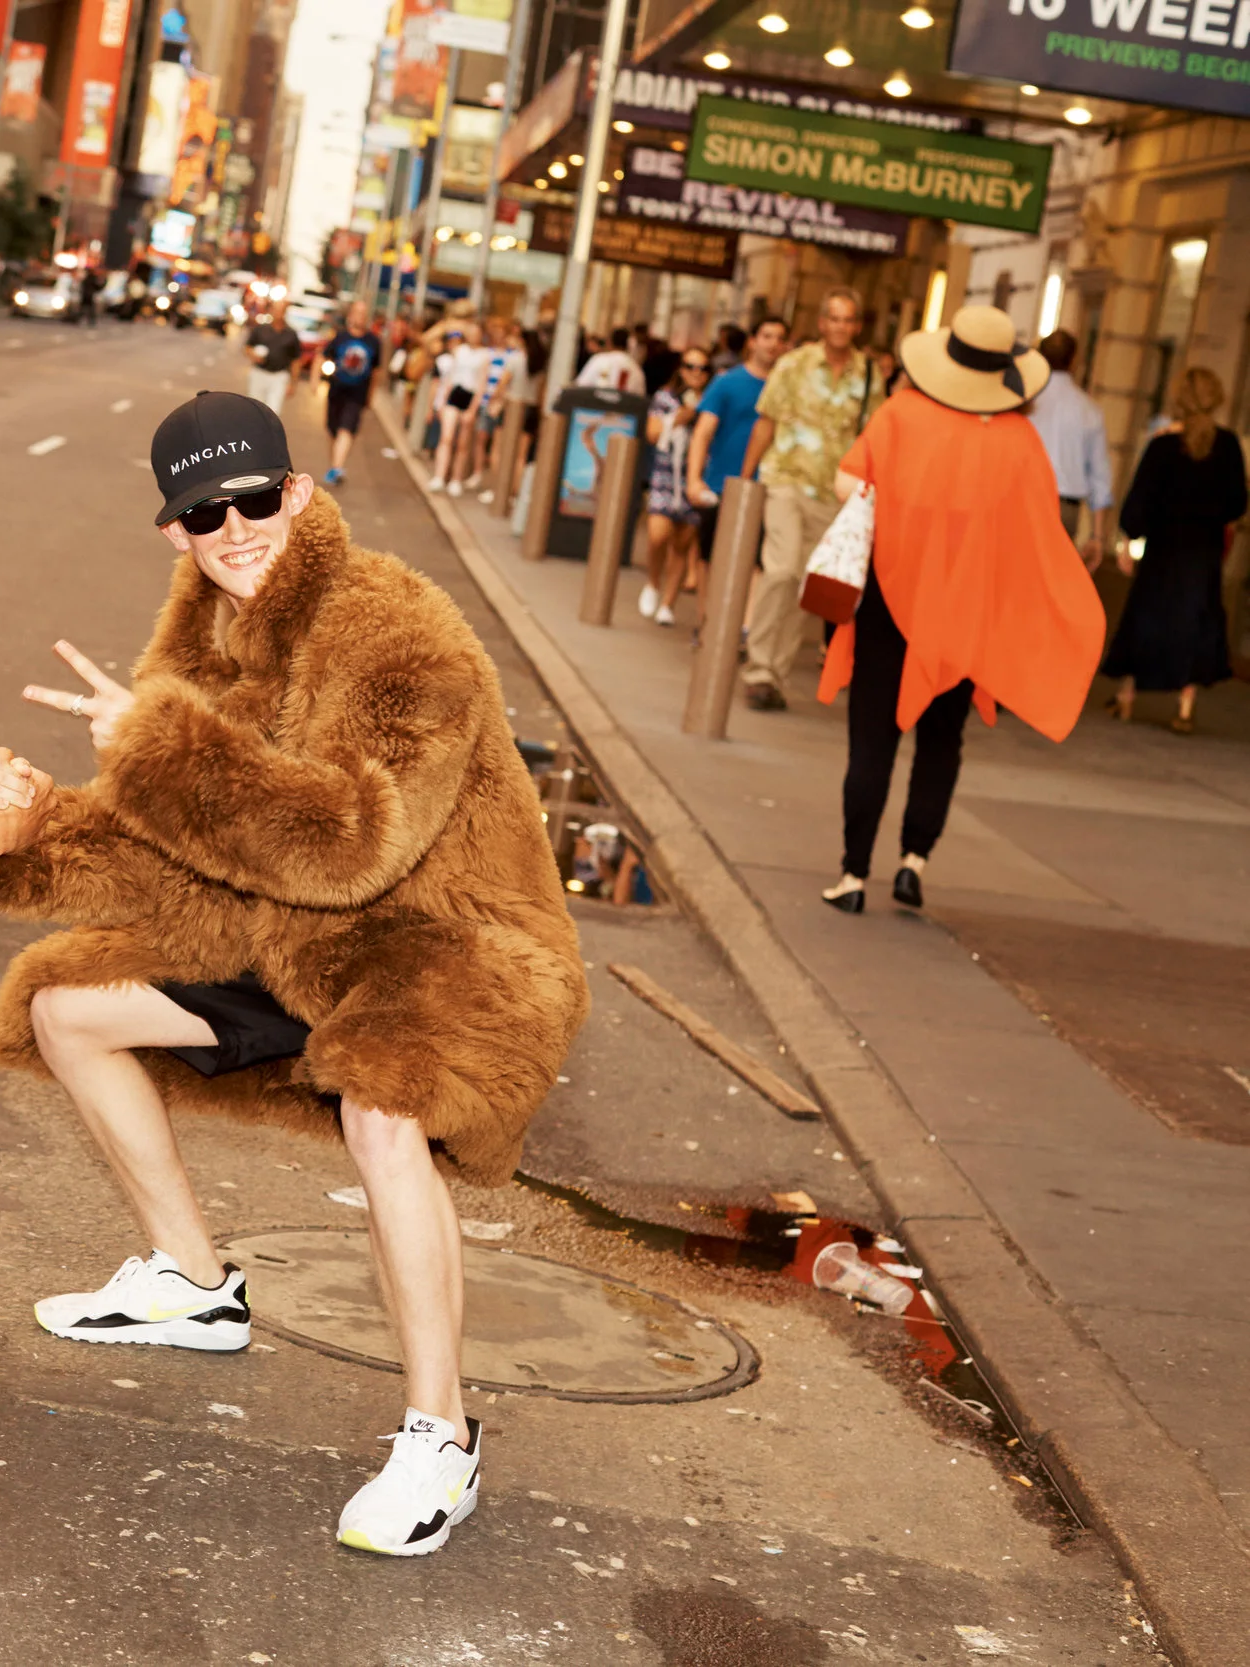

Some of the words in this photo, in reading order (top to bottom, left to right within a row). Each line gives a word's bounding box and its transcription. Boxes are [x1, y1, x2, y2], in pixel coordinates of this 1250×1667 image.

[1045, 31, 1181, 73] PREVIEWS
[612, 69, 726, 114] ADIAN
[702, 133, 823, 180] SIMON
[830, 154, 1034, 212] McBURNEY
[627, 195, 693, 222] TONY
[697, 207, 786, 236] AWARD
[791, 221, 898, 254] WINNER!
[682, 181, 846, 227] REVIVAL
[170, 440, 251, 476] MANGATA
[415, 1418, 437, 1431] NIKE
